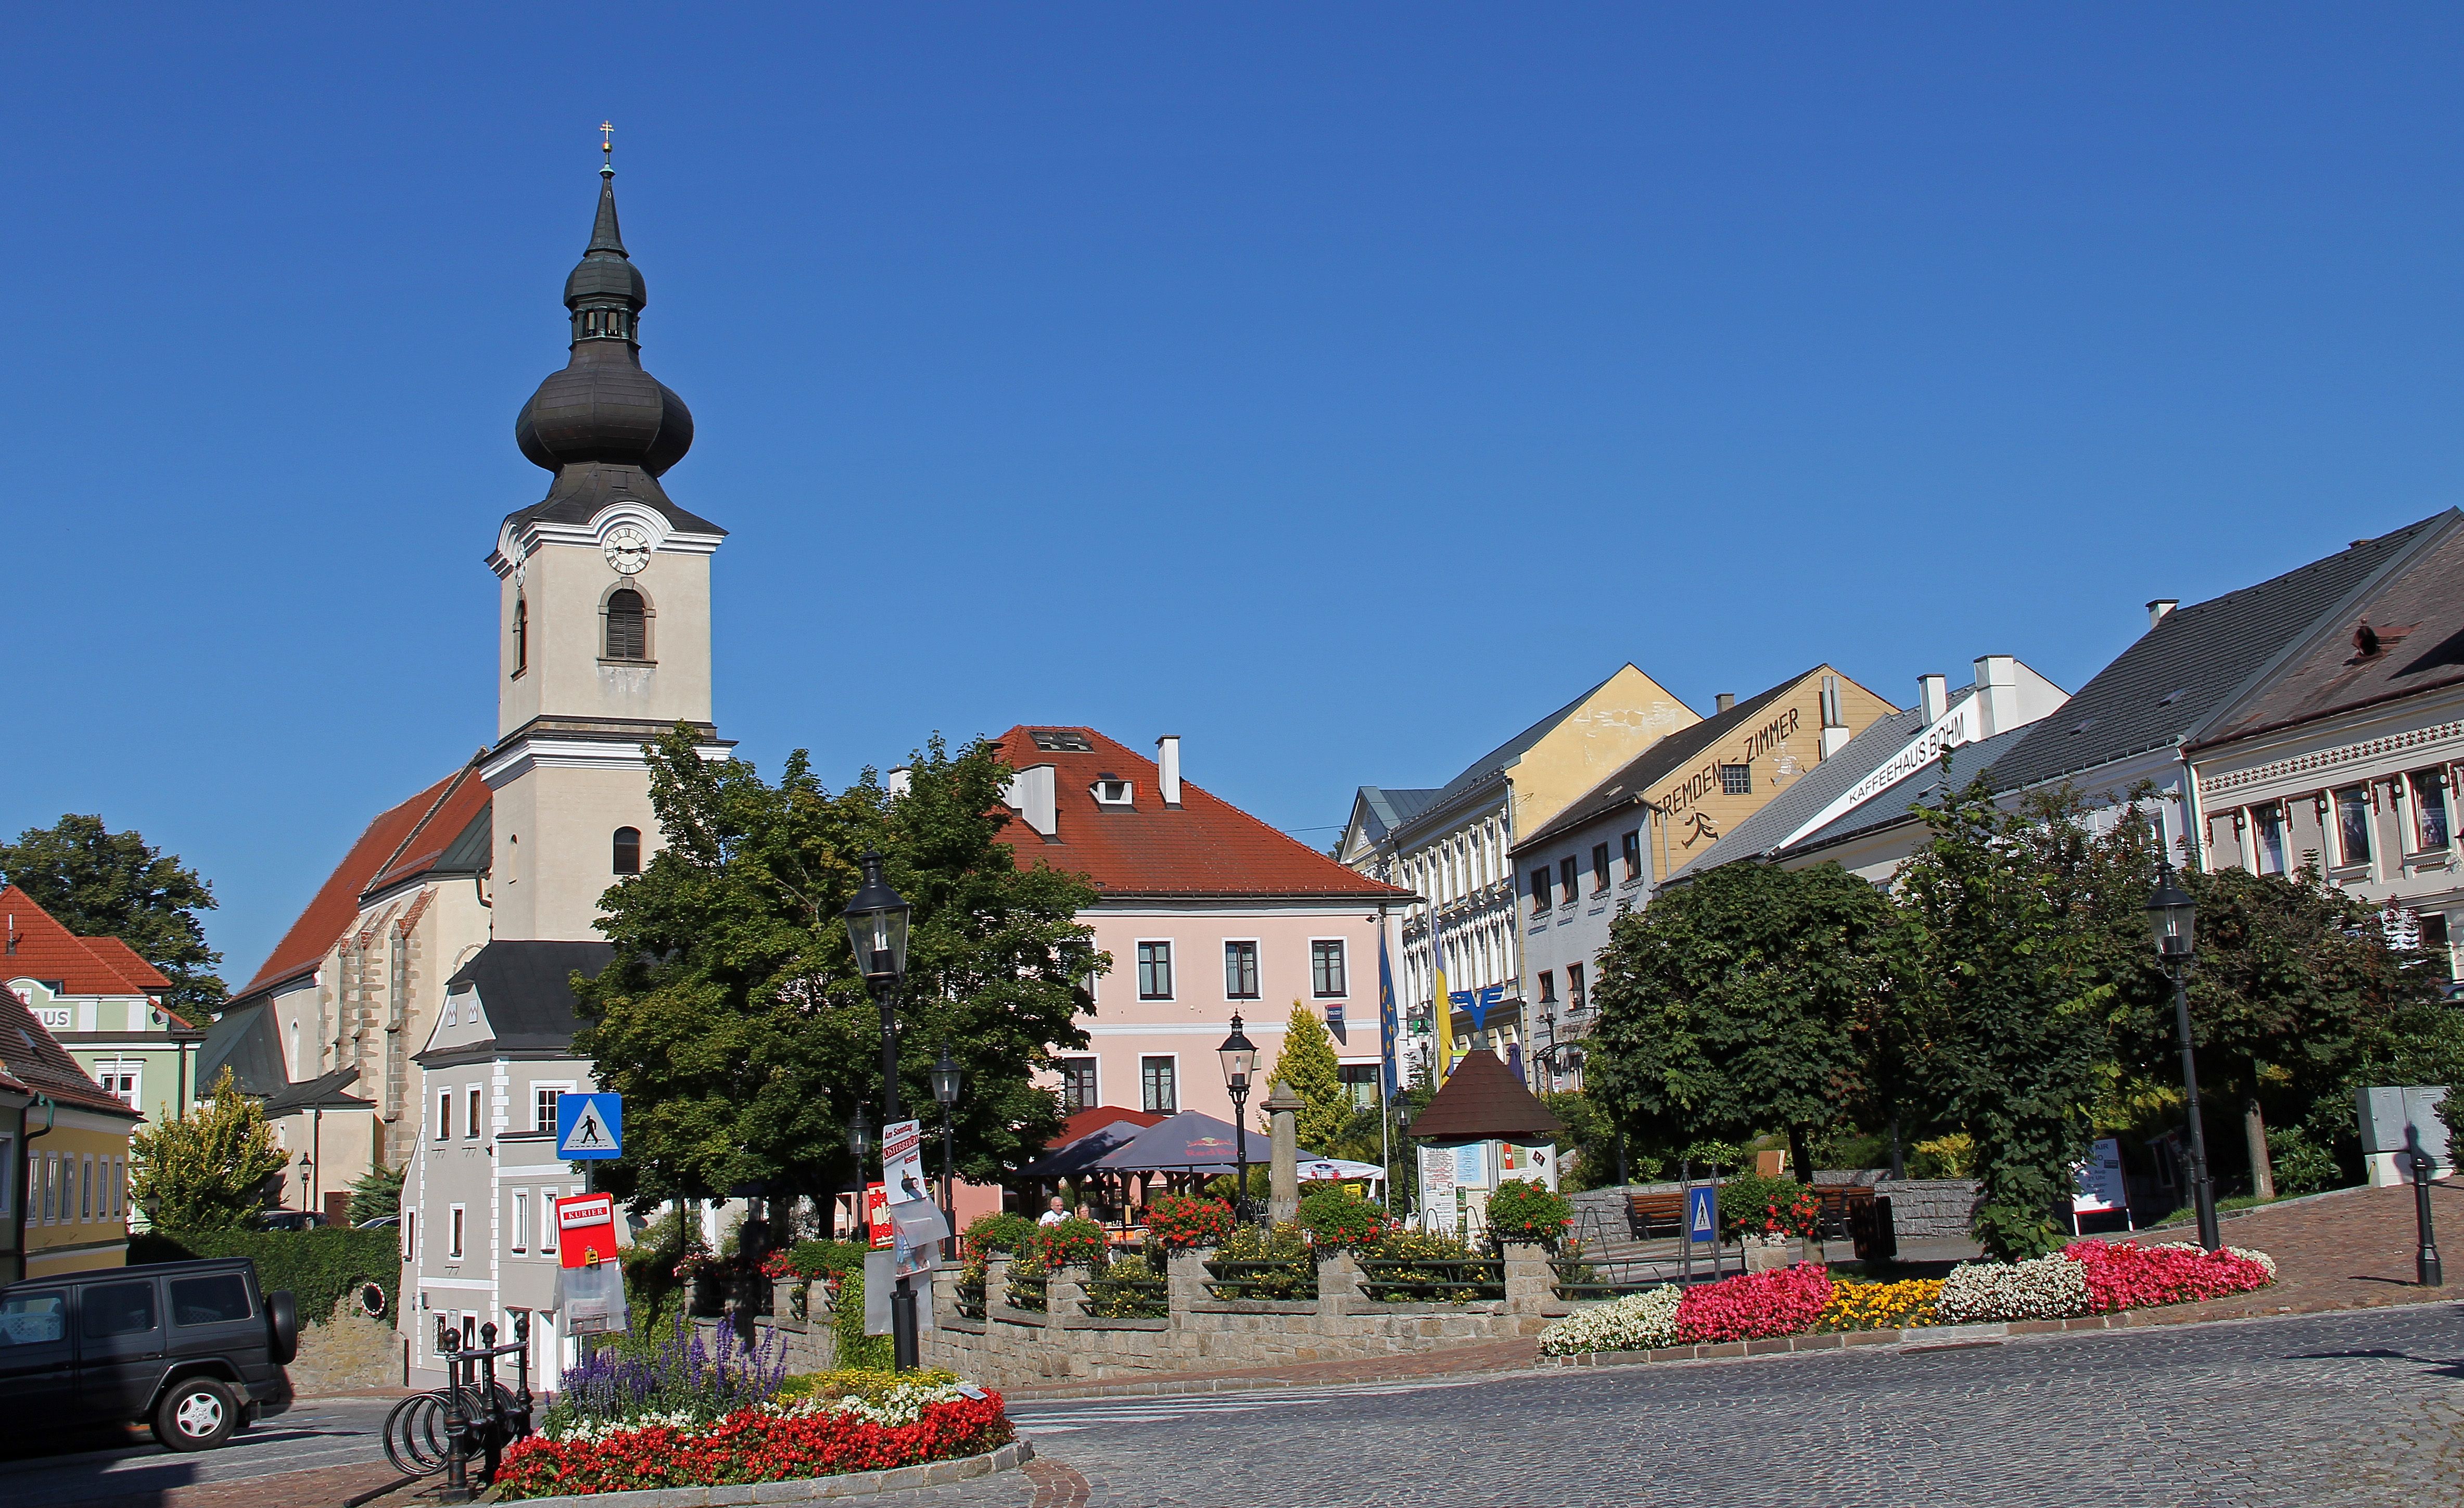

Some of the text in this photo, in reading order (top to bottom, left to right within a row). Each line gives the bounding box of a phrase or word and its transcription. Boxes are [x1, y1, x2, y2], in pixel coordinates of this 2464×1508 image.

[1849, 711, 1964, 804] KAFFEEHAUS BÖHM
[1654, 759, 1721, 827] FREMDEN
[1744, 708, 1799, 764] ZIMMER
[893, 1123, 913, 1136] Sonntag
[904, 1152, 919, 1165] lesen!
[1185, 1148, 1216, 1156] Red
[568, 1208, 603, 1219] KURIER
